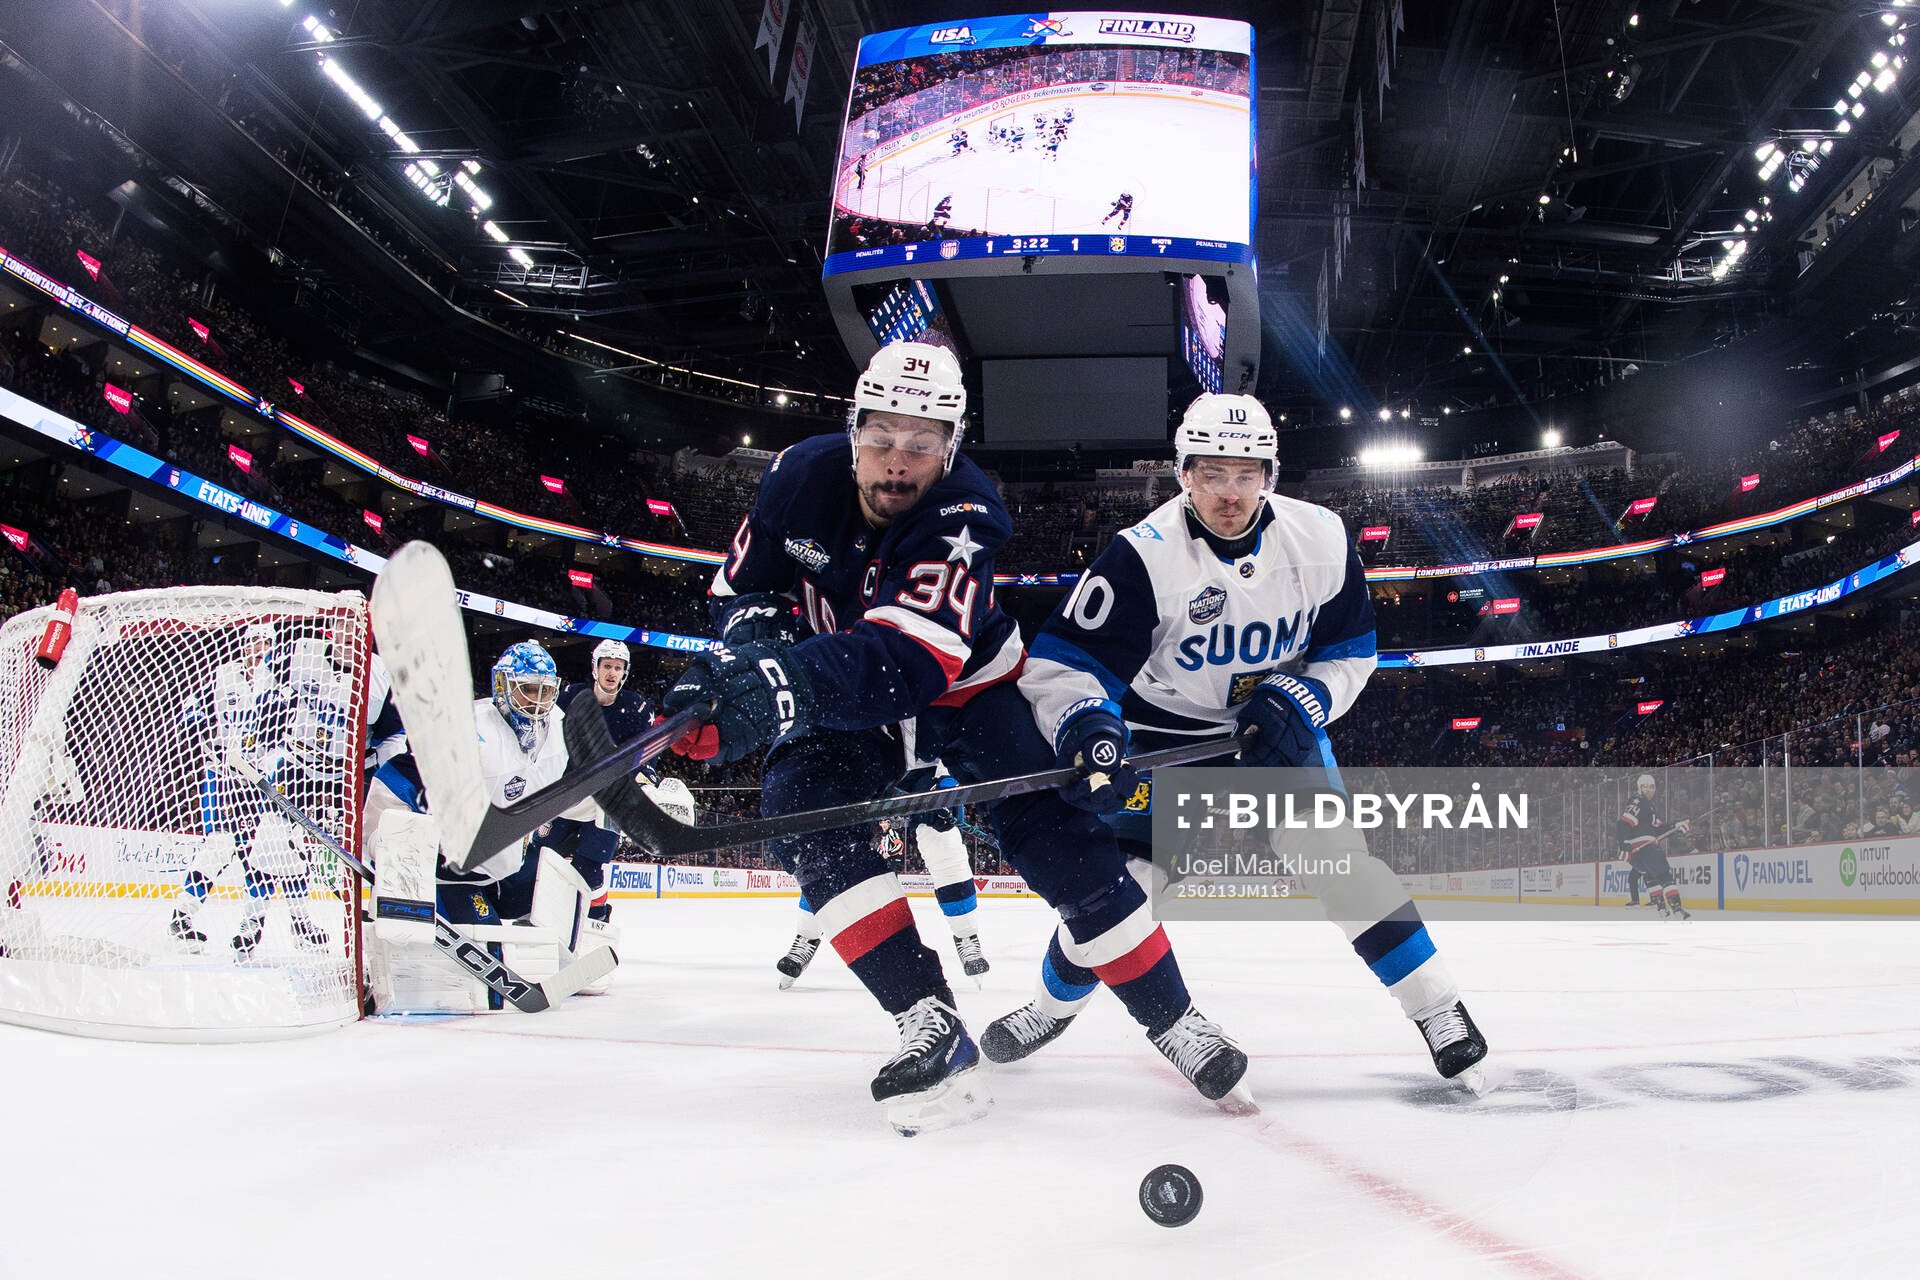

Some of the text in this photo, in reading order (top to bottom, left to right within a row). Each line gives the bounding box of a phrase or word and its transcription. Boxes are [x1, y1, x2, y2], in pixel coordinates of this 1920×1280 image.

[932, 27, 971, 43] USA
[1100, 19, 1194, 36] FINLAND
[985, 240, 993, 253] 1
[1013, 238, 1049, 249] 3:22
[1072, 238, 1079, 251] 1
[1158, 245, 1166, 254] 7
[4, 256, 69, 300] CONFRONTATION
[66, 292, 84, 309] DES
[91, 305, 129, 335] NATIONS
[903, 357, 930, 374] 34
[111, 391, 130, 407] ROGERS
[891, 384, 933, 398] CCM
[1228, 408, 1247, 423] 10
[1217, 431, 1252, 440] CCM
[443, 491, 476, 508] NATIONS
[1817, 483, 1868, 506] CONFRONTATION
[198, 481, 272, 527] ÉTATS-UNIS
[940, 503, 988, 517] DISCOVER
[785, 538, 831, 564] NATIONS
[1416, 564, 1474, 577] CONFRONTATION
[1475, 563, 1489, 571] DES
[1499, 558, 1535, 569] NATIONS
[863, 566, 877, 597] C
[896, 561, 979, 637] 34
[1062, 568, 1115, 630] 10
[1190, 591, 1226, 610] NATIONS
[1778, 583, 1841, 614] ÉTATS-UNIS
[1175, 608, 1314, 671] SUOMI
[673, 683, 702, 692] CCM
[609, 864, 653, 889] FASTENAL
[677, 872, 704, 885] FANDUEL
[746, 870, 771, 889] TYLENOL
[1696, 865, 1712, 885] 25
[1752, 859, 1814, 885] FANDUEL
[991, 881, 1027, 890] CANADIAN
